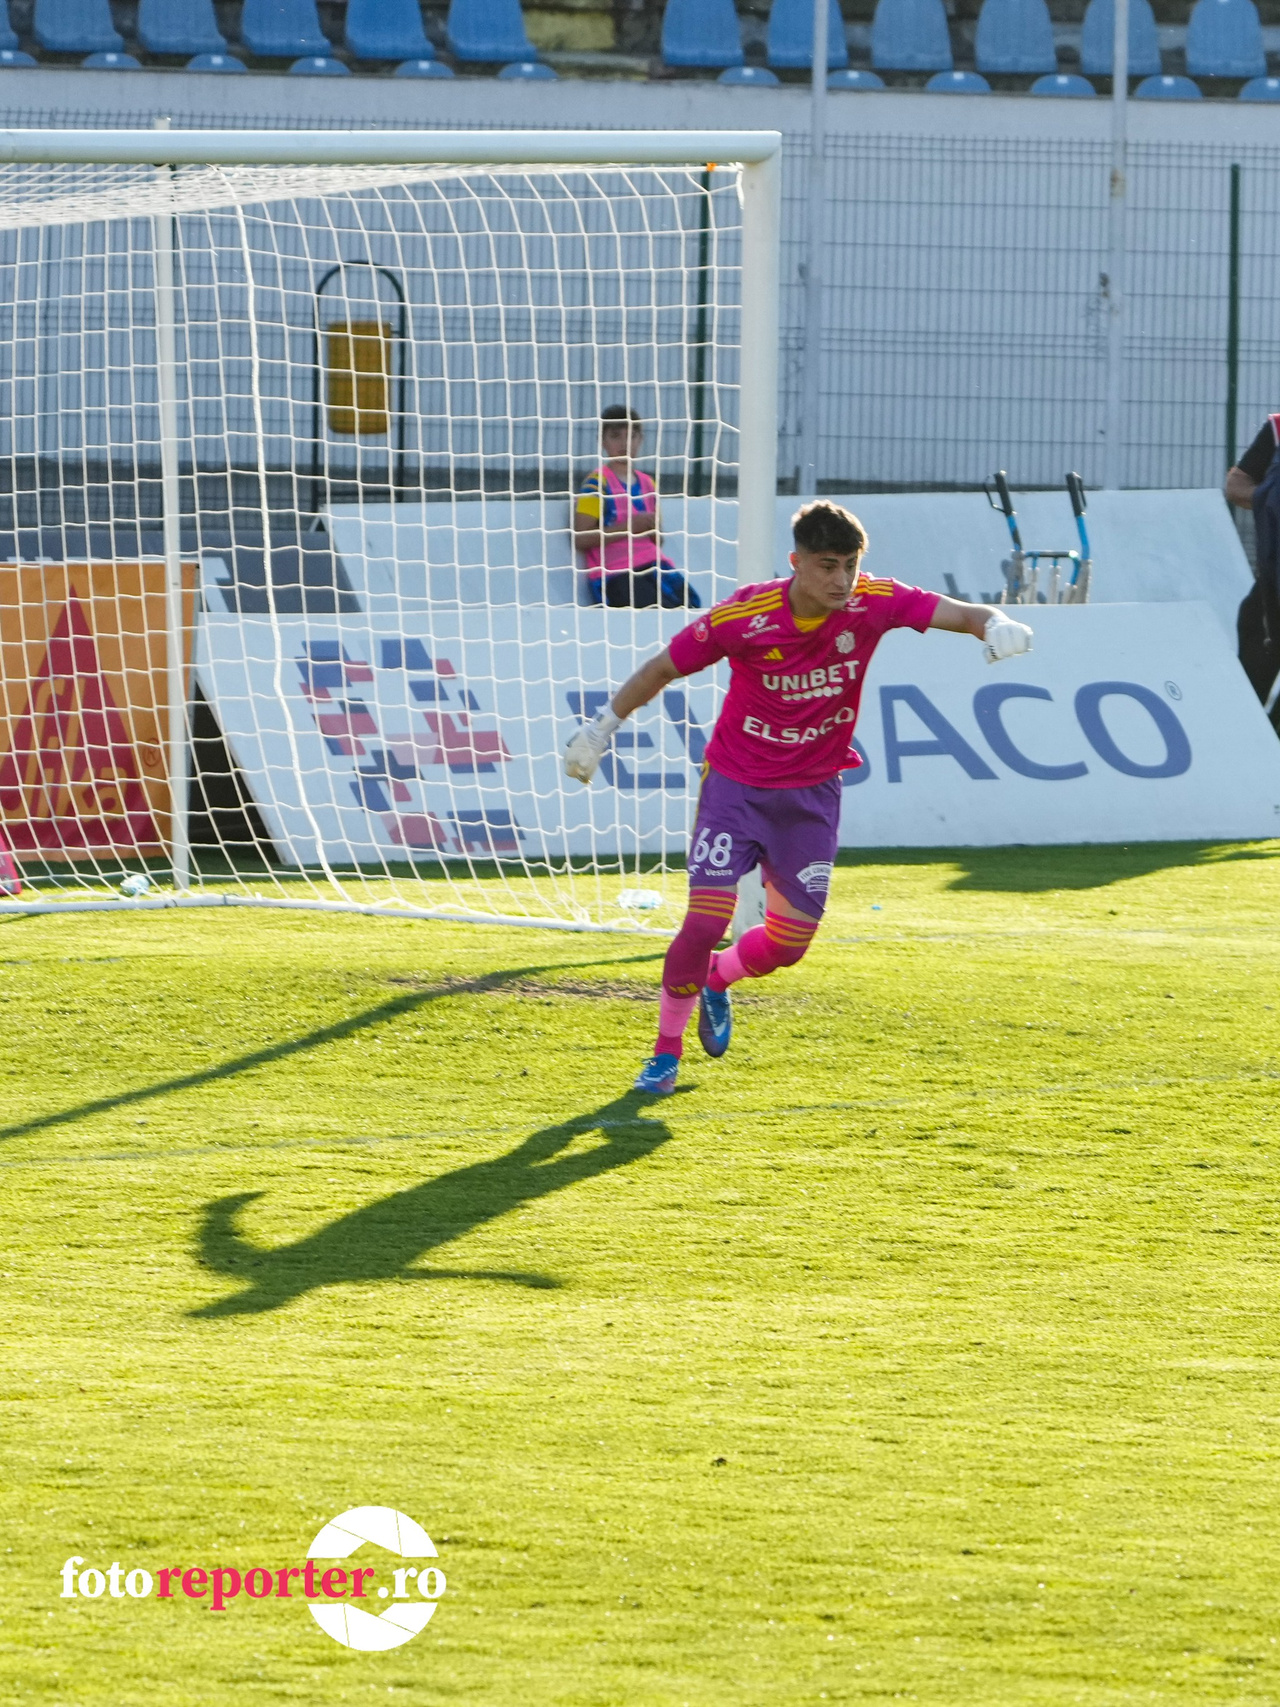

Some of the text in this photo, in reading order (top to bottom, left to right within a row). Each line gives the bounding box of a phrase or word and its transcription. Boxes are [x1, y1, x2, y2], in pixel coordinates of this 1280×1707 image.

[762, 660, 860, 691] UNIBET
[566, 681, 1192, 790] EACO
[742, 706, 855, 744] ELSACO
[693, 827, 733, 867] 68
